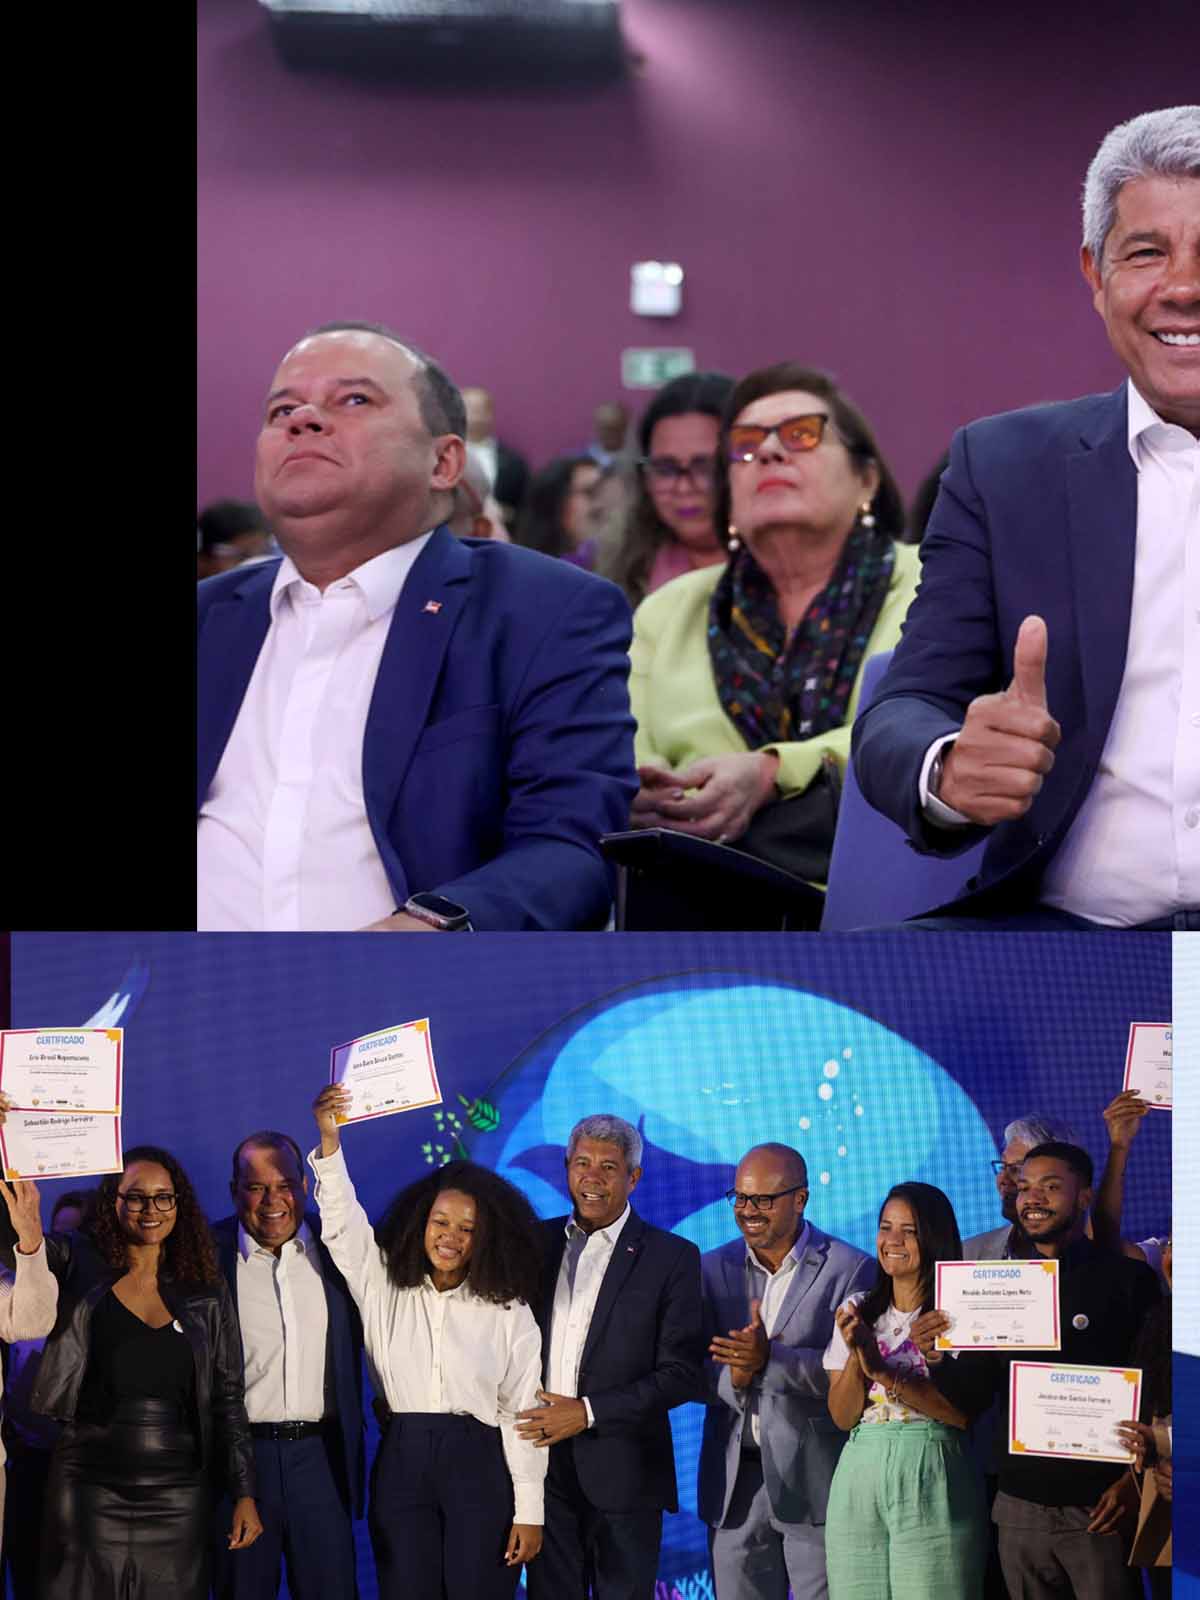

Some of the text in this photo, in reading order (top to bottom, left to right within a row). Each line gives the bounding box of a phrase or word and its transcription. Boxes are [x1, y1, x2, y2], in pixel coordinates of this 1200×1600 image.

[36, 1035, 85, 1045] CERTIFICADO
[358, 1034, 398, 1053] CERTIFICADO
[973, 1269, 1021, 1279] CERTIFICADO
[1050, 1373, 1101, 1385] CERTIFICADO
